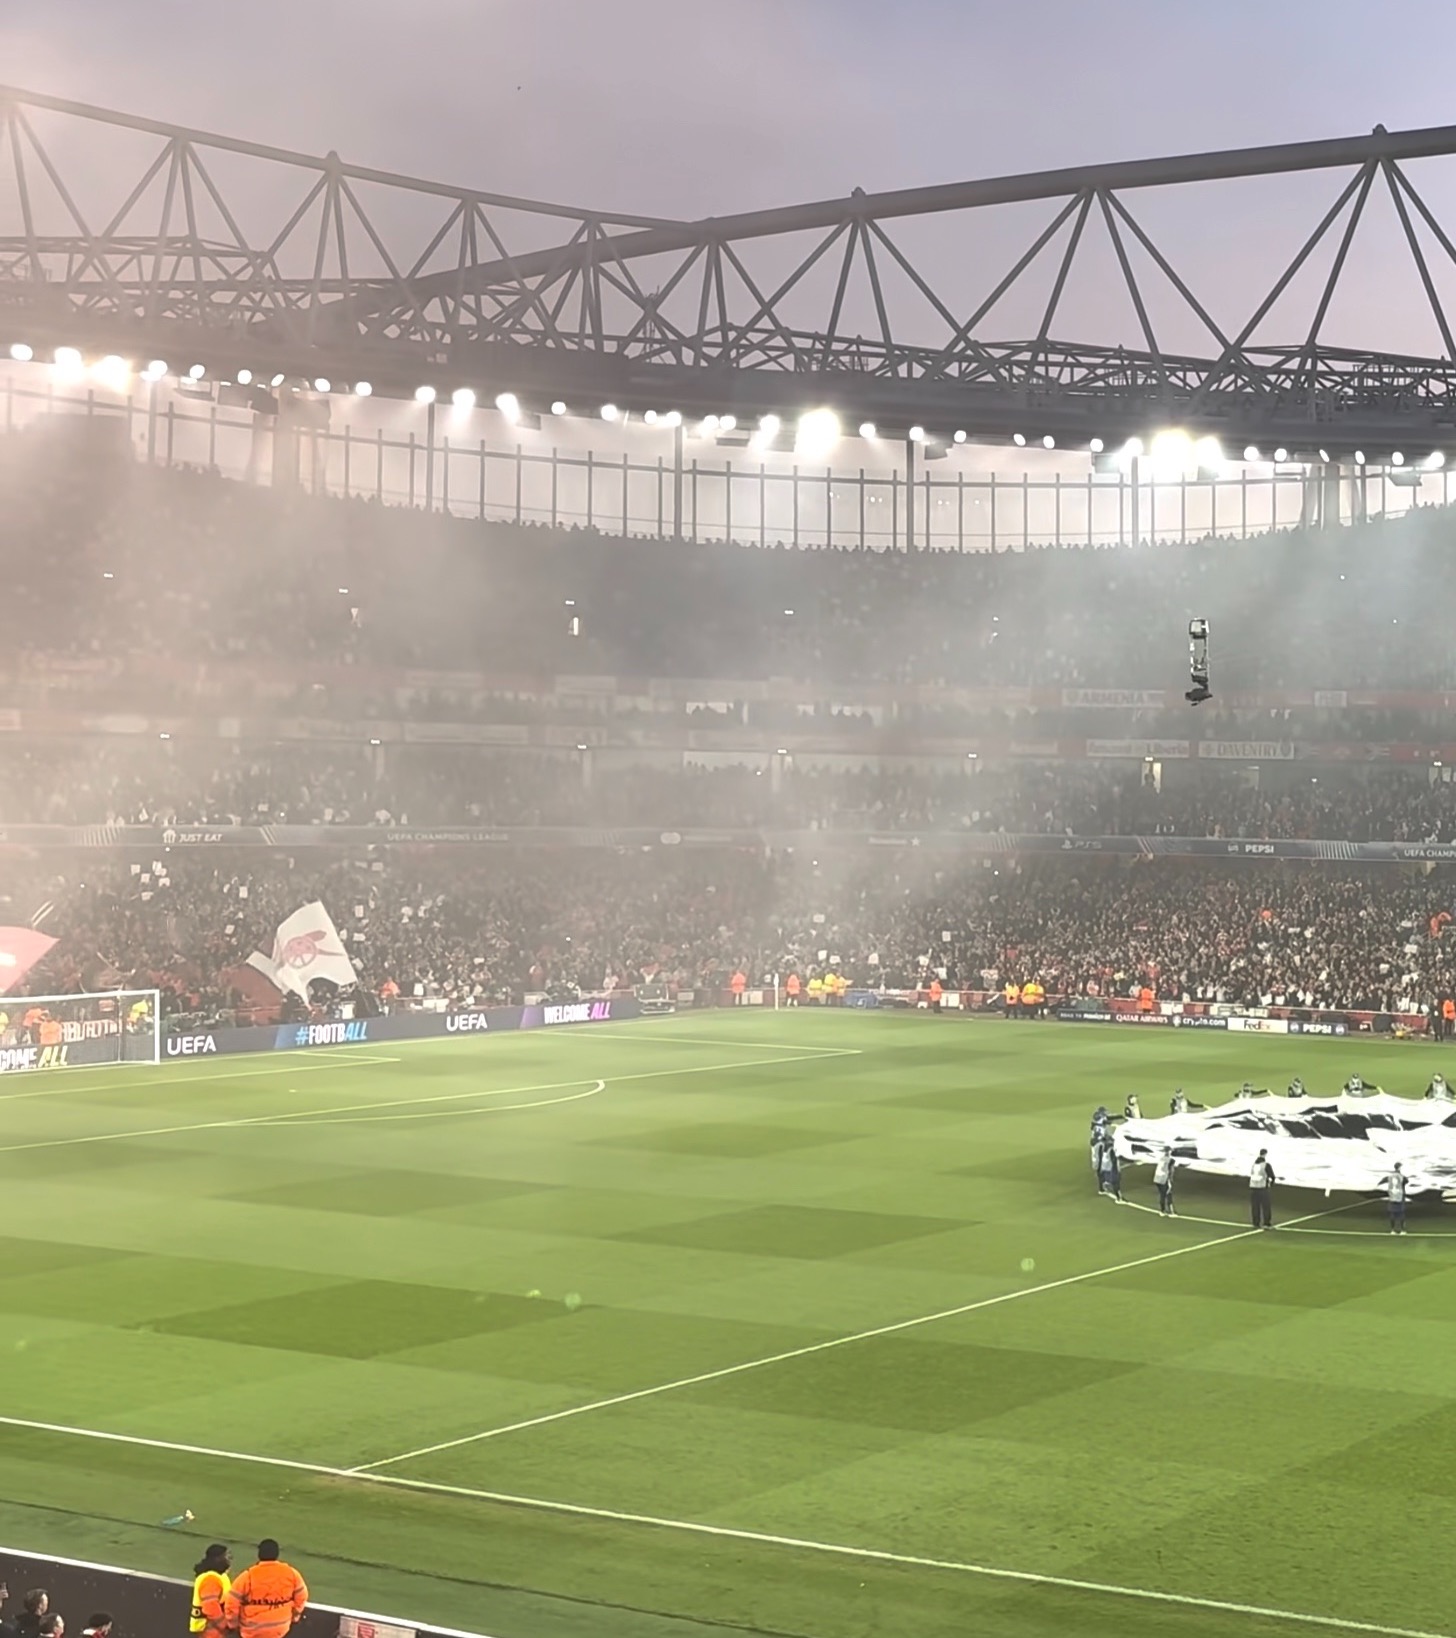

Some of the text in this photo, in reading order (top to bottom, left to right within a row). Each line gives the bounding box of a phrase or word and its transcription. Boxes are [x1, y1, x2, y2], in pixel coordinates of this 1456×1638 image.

[179, 833, 223, 843] JUST EAT
[415, 833, 471, 841] CHAMPIONS
[1245, 845, 1274, 853] PEPSI
[1404, 849, 1424, 857] UEFA
[544, 1001, 611, 1024] WELCOME ALL
[447, 1013, 487, 1031] UEFA
[1116, 1015, 1139, 1023] QATAR
[1140, 1015, 1168, 1024] AIRWAYS
[1244, 1020, 1270, 1030] FedEx
[1303, 1023, 1331, 1034] PEPSI
[296, 1021, 368, 1045] #FOOTBALL
[167, 1034, 217, 1055] UEFA
[38, 1045, 68, 1067] ALL
